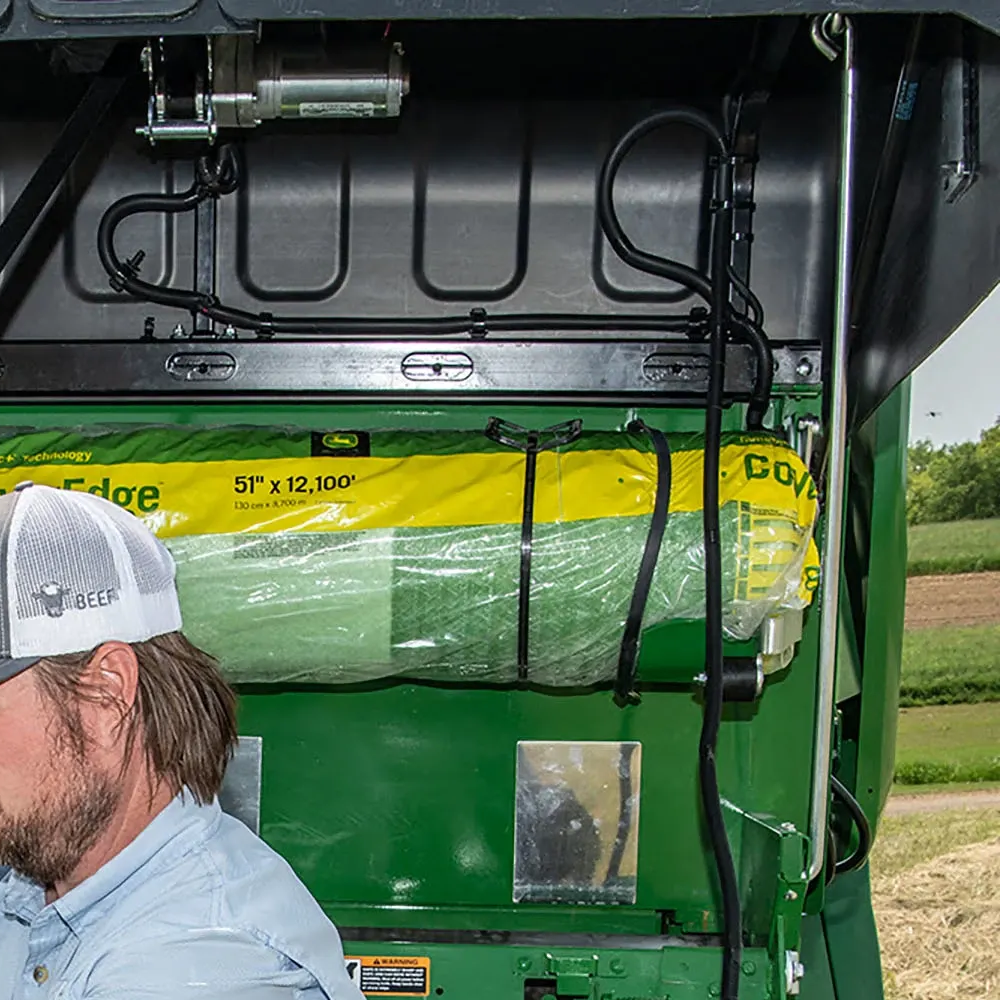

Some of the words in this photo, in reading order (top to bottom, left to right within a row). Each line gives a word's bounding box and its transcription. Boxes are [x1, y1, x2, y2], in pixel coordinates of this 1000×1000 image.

[234, 475, 264, 494] 51"
[269, 480, 281, 494] x
[286, 474, 356, 495] 12,100'
[76, 588, 115, 610] BEEF
